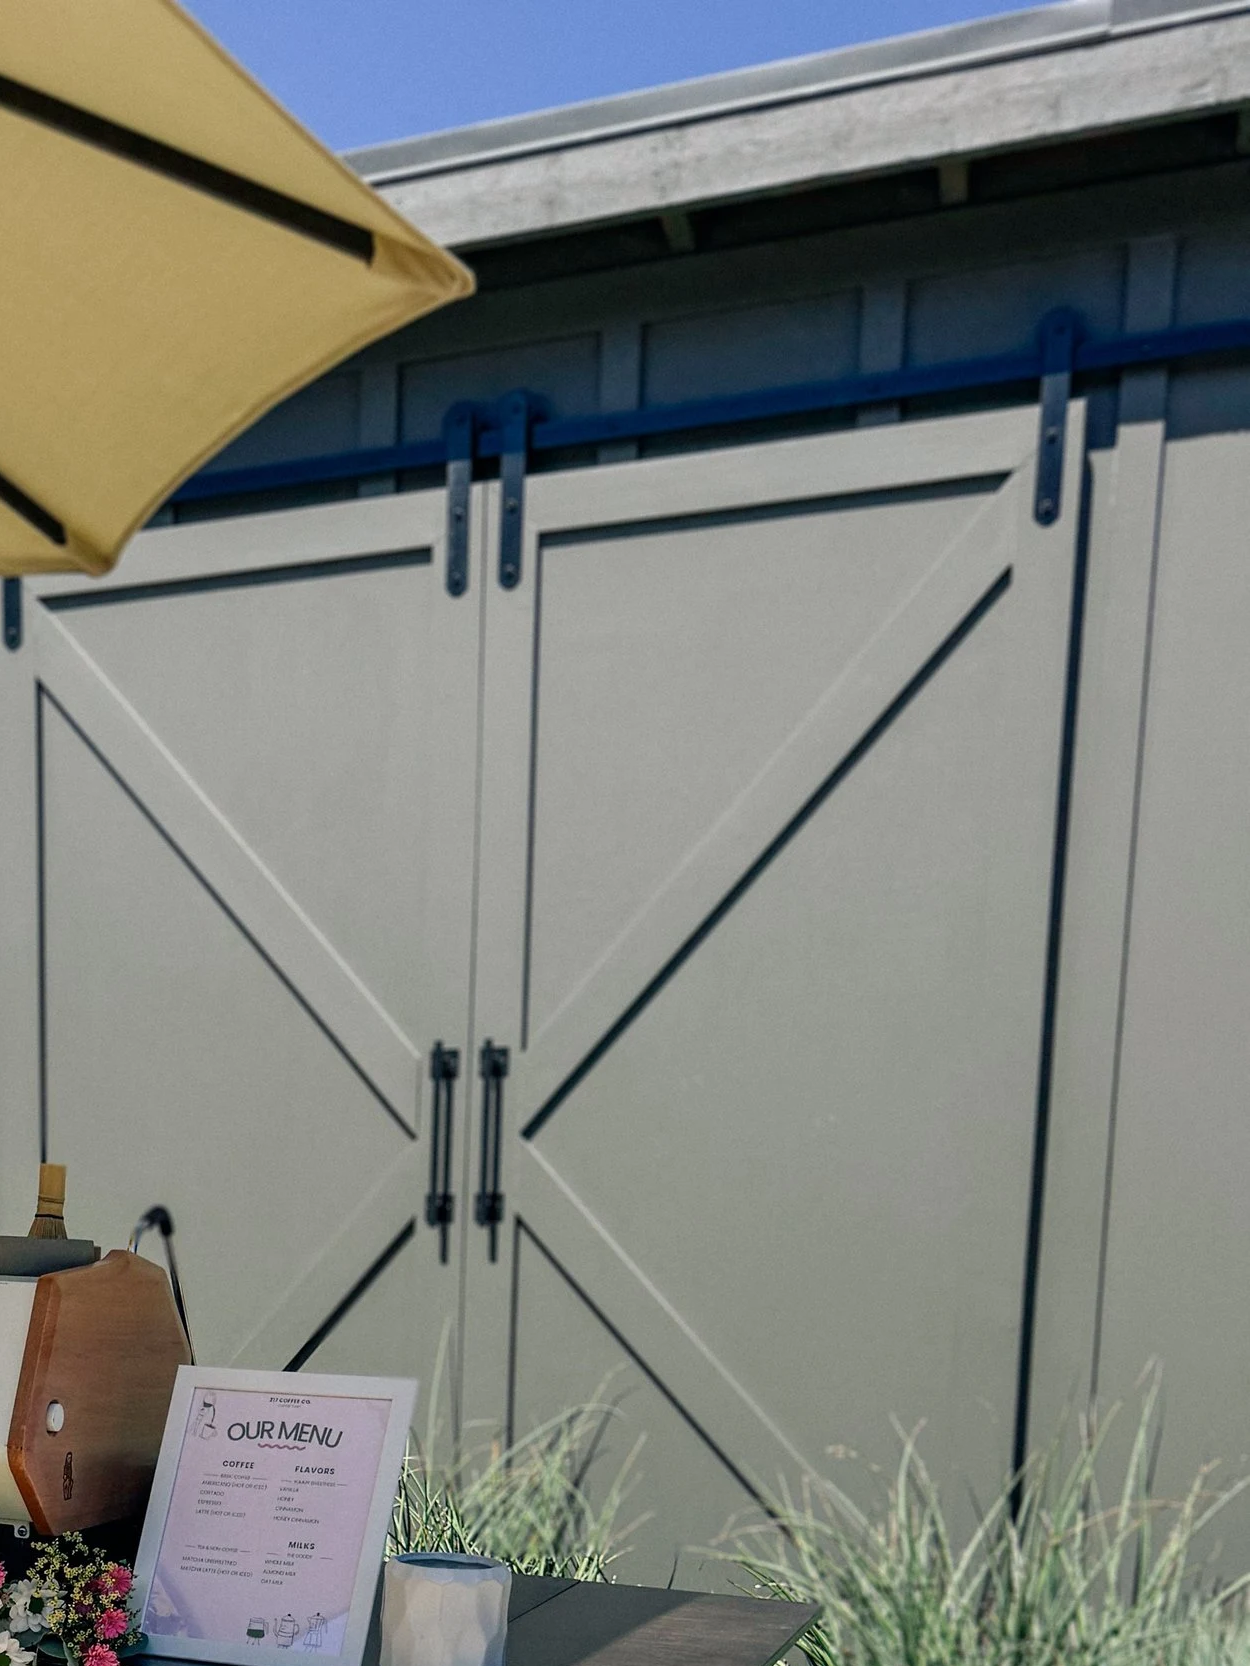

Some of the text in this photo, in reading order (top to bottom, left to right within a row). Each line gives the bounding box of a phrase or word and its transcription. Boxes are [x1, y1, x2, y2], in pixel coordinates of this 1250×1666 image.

[227, 1420, 343, 1448] OUR MENU
[222, 1460, 255, 1469] COFFEE
[294, 1465, 335, 1475] FLAVORS
[199, 1489, 225, 1497] CORTADO
[288, 1541, 315, 1550] MILKS
